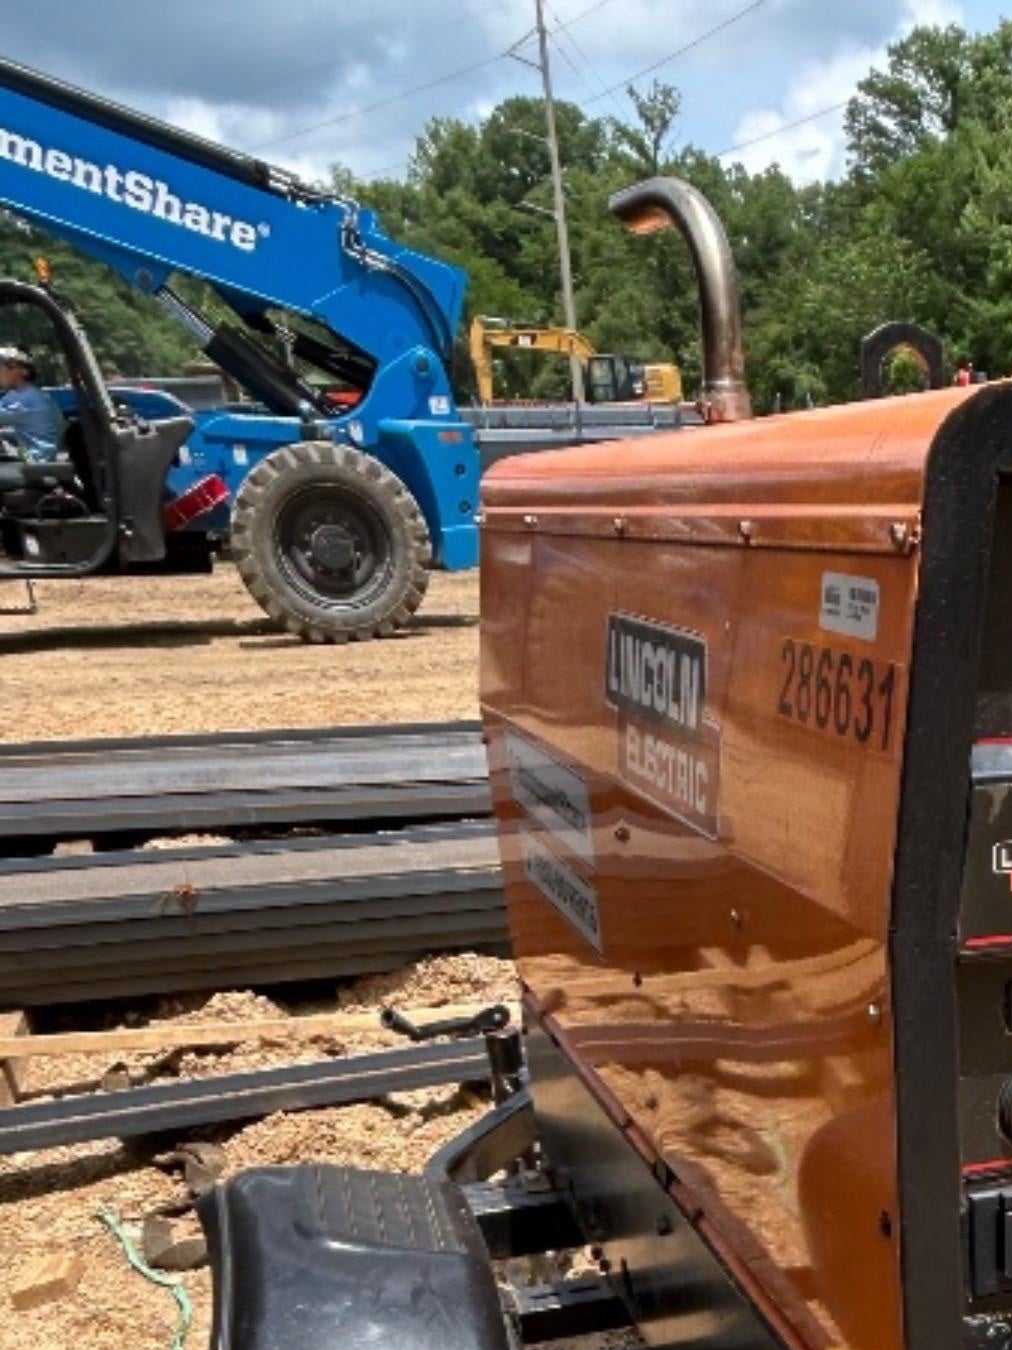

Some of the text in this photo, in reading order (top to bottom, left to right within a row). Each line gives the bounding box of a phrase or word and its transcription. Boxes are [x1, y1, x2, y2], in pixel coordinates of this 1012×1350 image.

[609, 627, 700, 730] LINCOLN
[776, 638, 897, 750] 286631
[626, 721, 708, 815] ELECTRIC
